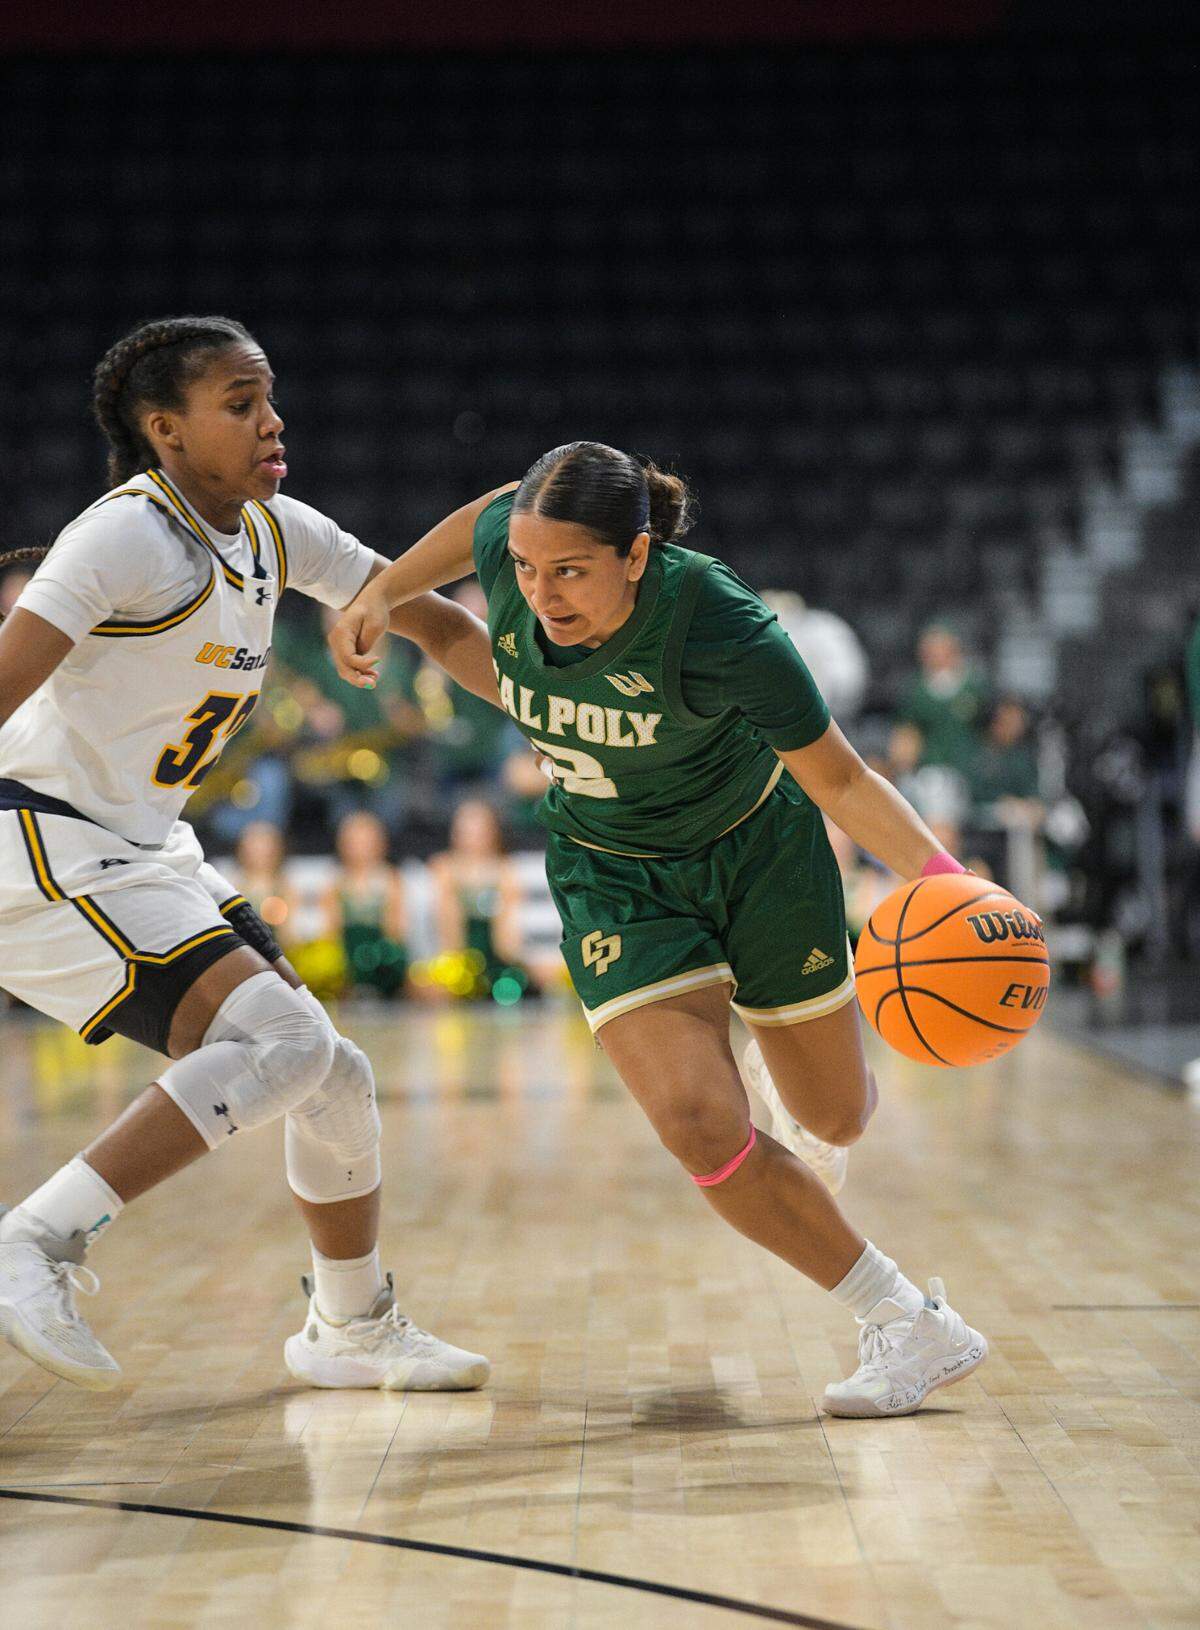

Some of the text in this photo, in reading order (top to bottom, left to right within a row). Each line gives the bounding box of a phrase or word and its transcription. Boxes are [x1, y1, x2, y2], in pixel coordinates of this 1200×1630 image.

[492, 657, 663, 748] AL POLY
[965, 908, 1046, 944] Wilso
[801, 956, 835, 976] adidas
